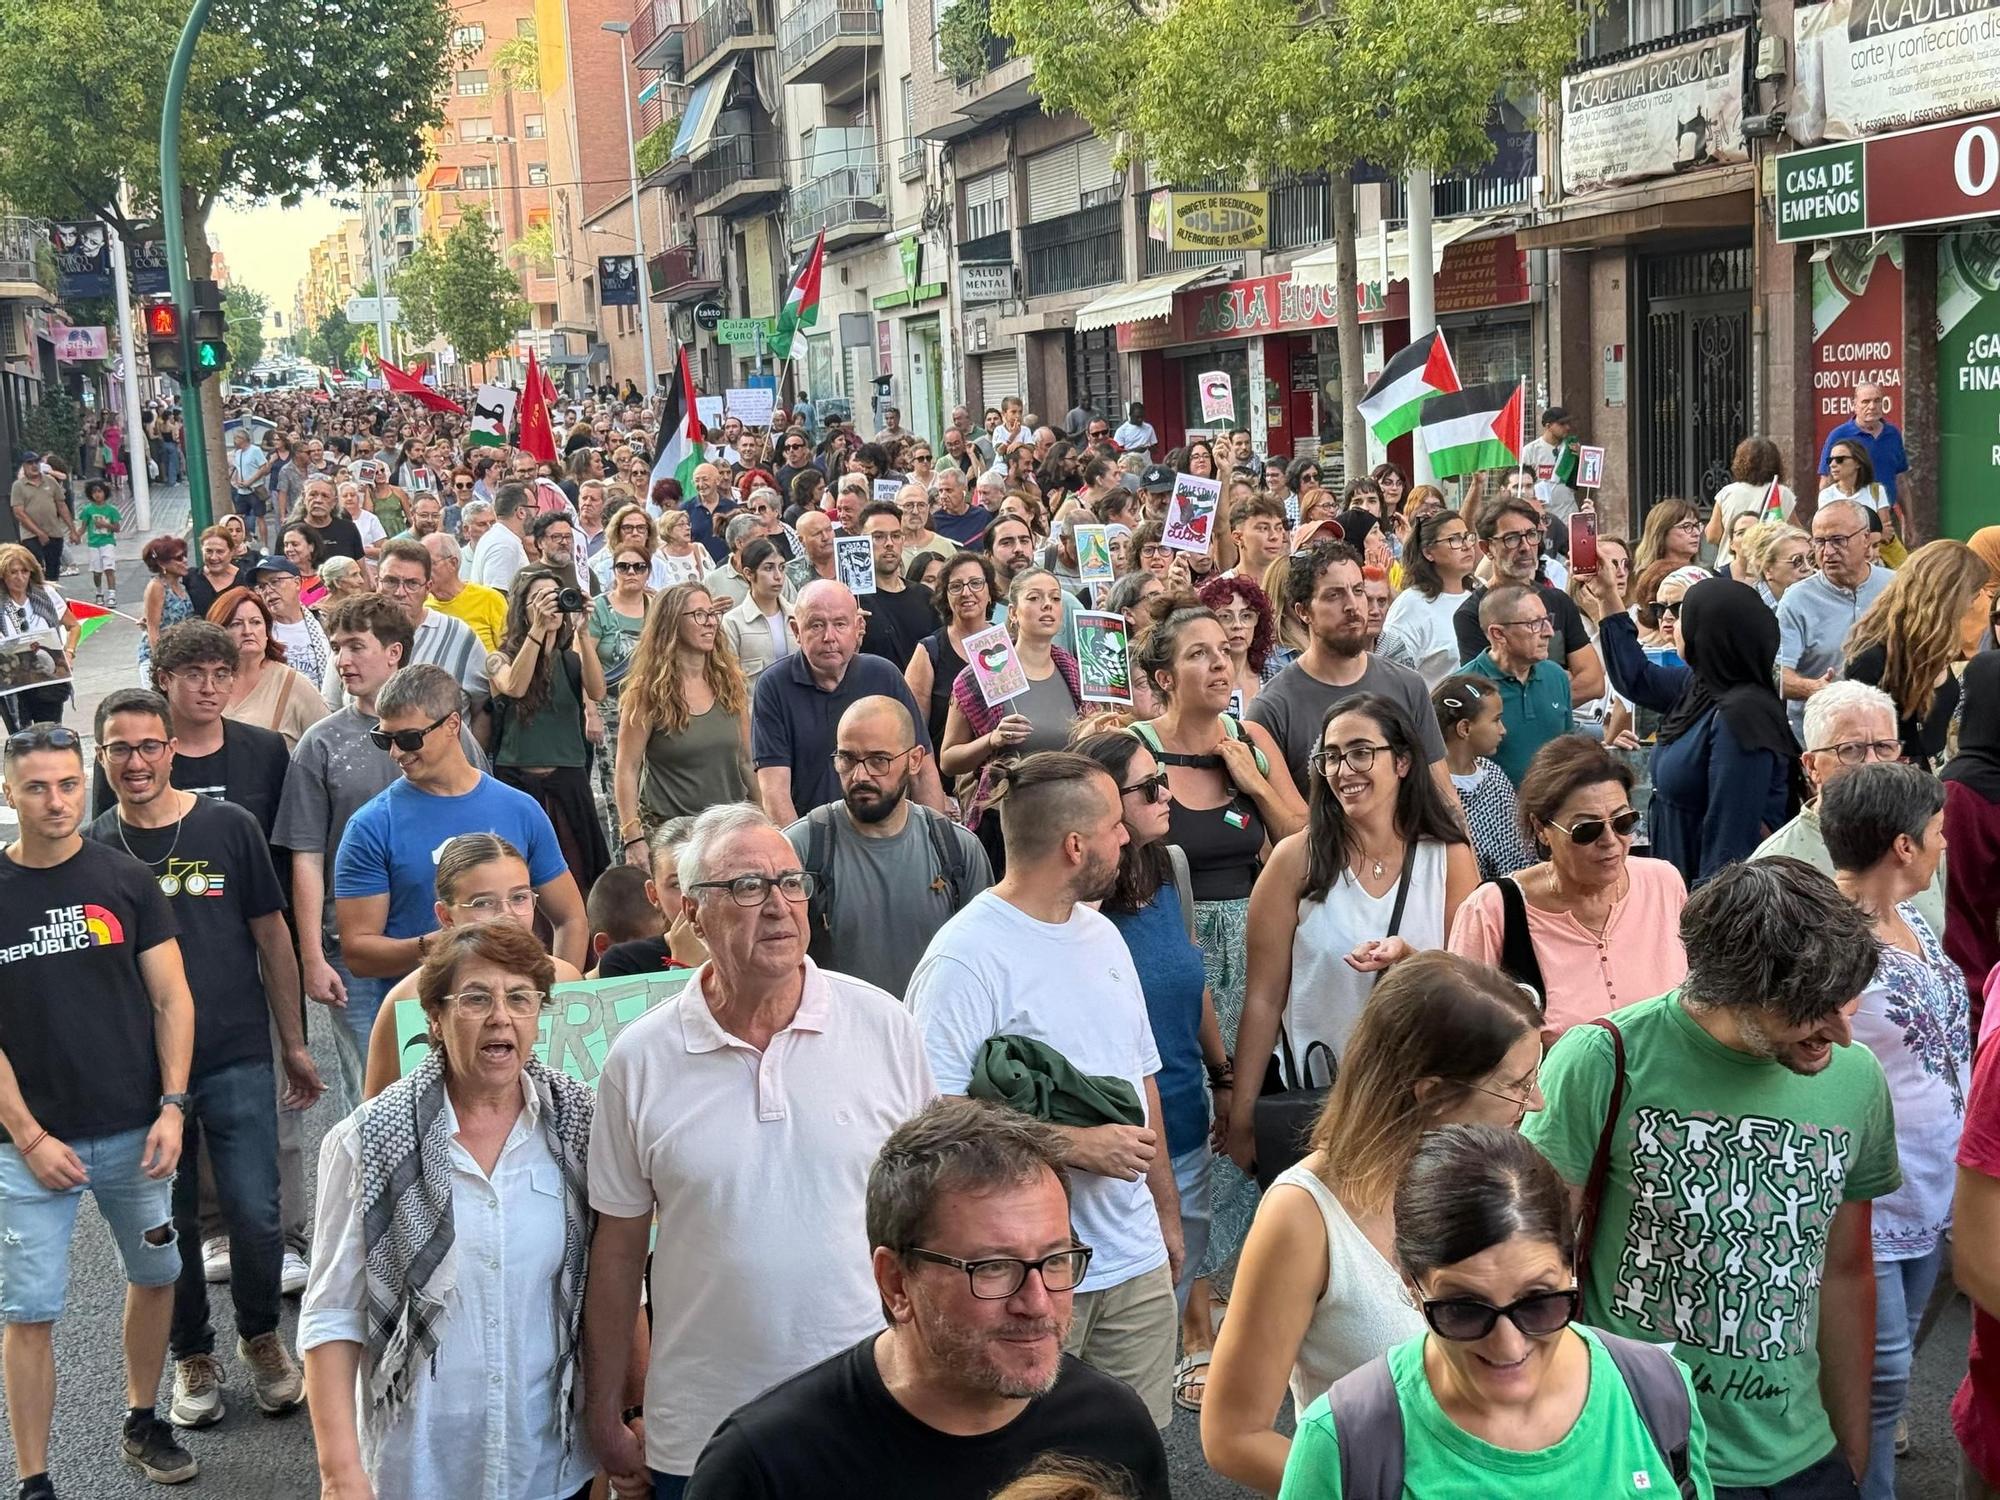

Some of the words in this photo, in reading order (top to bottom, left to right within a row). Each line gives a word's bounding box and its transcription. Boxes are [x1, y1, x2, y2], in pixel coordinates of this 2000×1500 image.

[1851, 44, 1884, 70] corte
[1887, 43, 1895, 67] y
[1899, 19, 1978, 58] confección
[1572, 68, 1645, 111] ACADEMIA
[1653, 91, 1673, 106] moda
[1786, 168, 1827, 194] CASA
[1832, 160, 1855, 187] DE
[1208, 197, 1218, 208] DE
[1782, 189, 1860, 224] EMPEÑOS
[1228, 235, 1241, 246] DEL
[968, 268, 1003, 278] SALUD
[965, 279, 1009, 289] MENTAL
[698, 308, 721, 317] takto
[1198, 286, 1270, 332] ASIA
[722, 321, 767, 331] Calzados
[1823, 345, 1836, 362] EL
[1837, 341, 1891, 361] COMPRO
[1814, 371, 1840, 389] ORO
[1840, 371, 1849, 388] Y
[1852, 370, 1867, 388] LA
[1868, 368, 1900, 387] CASA
[882, 385, 889, 394] P
[1822, 398, 1837, 415] DE
[45, 904, 86, 924] THE
[28, 920, 88, 941] THIRD
[0, 934, 90, 965] REPUBLIC
